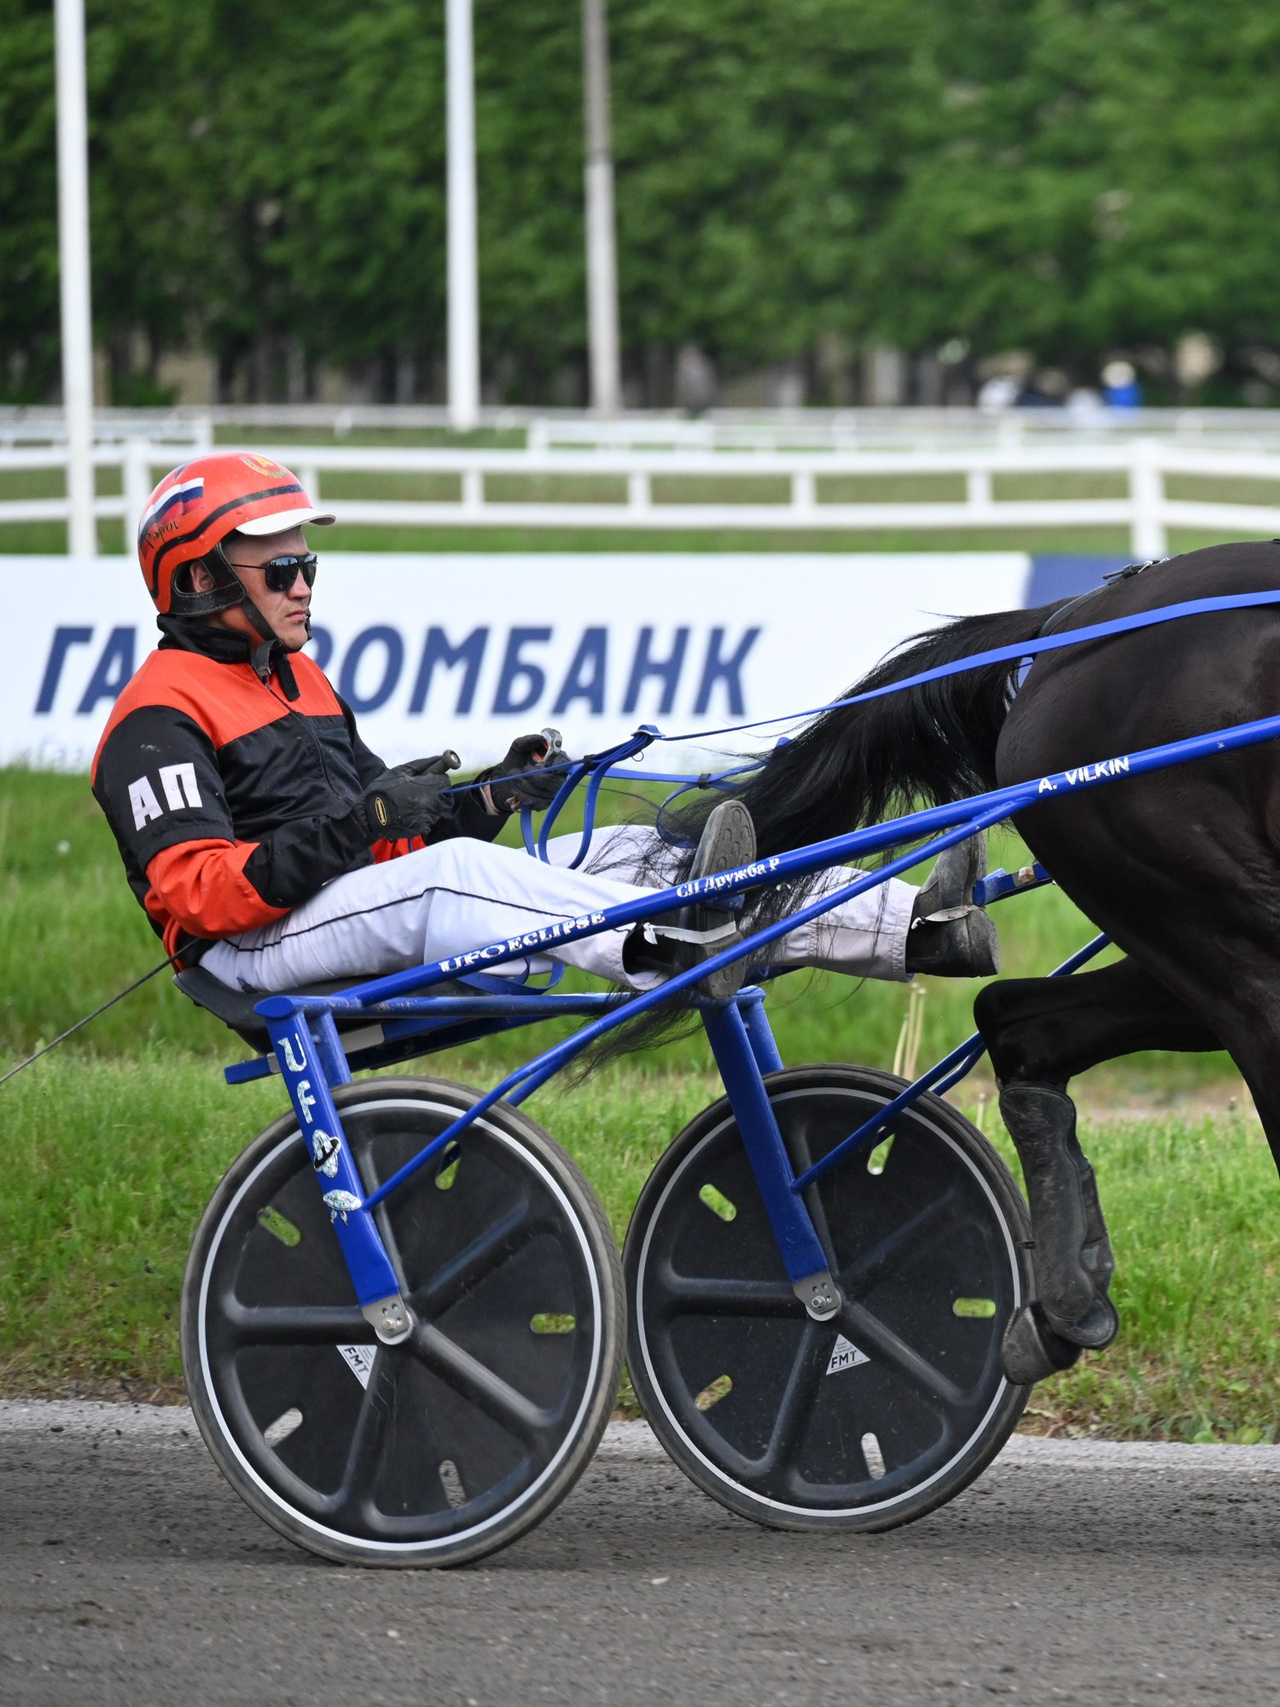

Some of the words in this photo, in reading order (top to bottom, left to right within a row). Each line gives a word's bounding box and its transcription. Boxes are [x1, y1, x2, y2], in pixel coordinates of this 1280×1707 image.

[34, 626, 762, 714] ГАОМБАНК
[1038, 777, 1058, 794] A.
[1064, 757, 1130, 785] VILKIN
[127, 762, 203, 832] АП
[703, 862, 767, 893] Дружба
[438, 943, 506, 973] UFO
[507, 911, 606, 952] ECLIPSE
[343, 1346, 370, 1373] FMT
[831, 1349, 857, 1369] FMT
